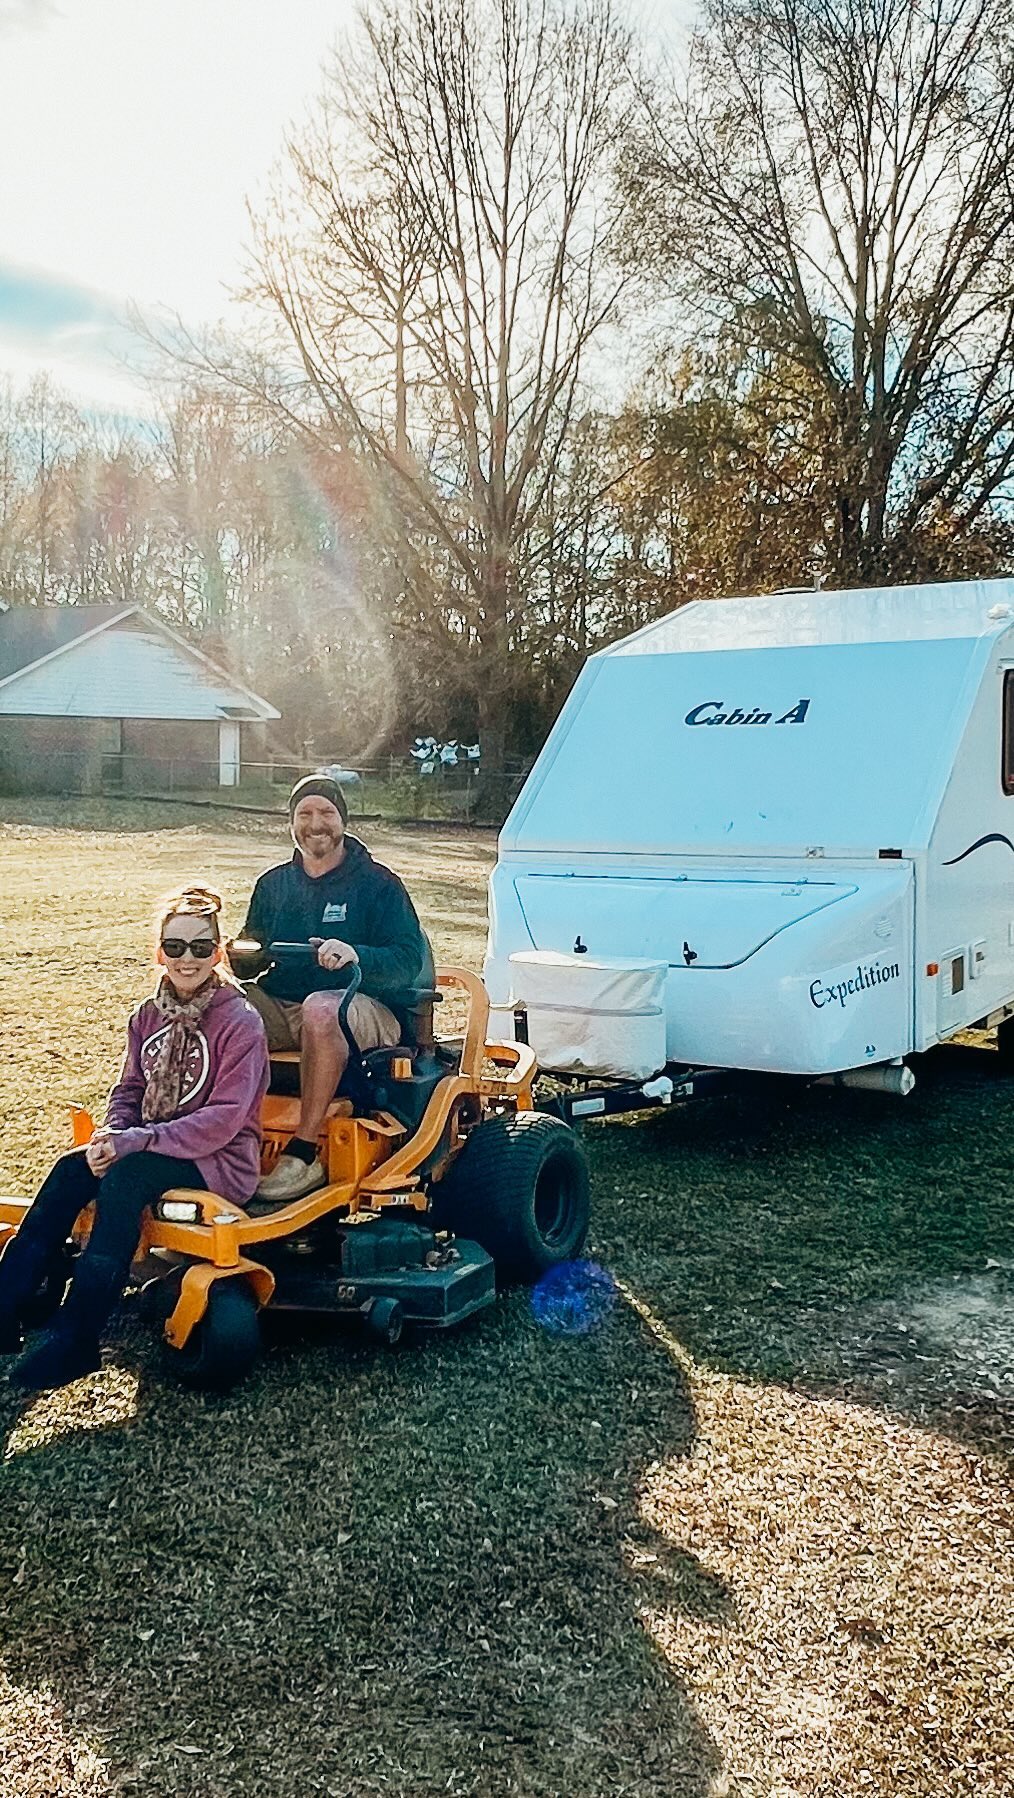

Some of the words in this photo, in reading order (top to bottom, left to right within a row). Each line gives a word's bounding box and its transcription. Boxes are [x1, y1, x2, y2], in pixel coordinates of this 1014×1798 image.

[684, 701, 773, 726] Cabin
[774, 698, 811, 725] A
[809, 962, 900, 1009] Expedition
